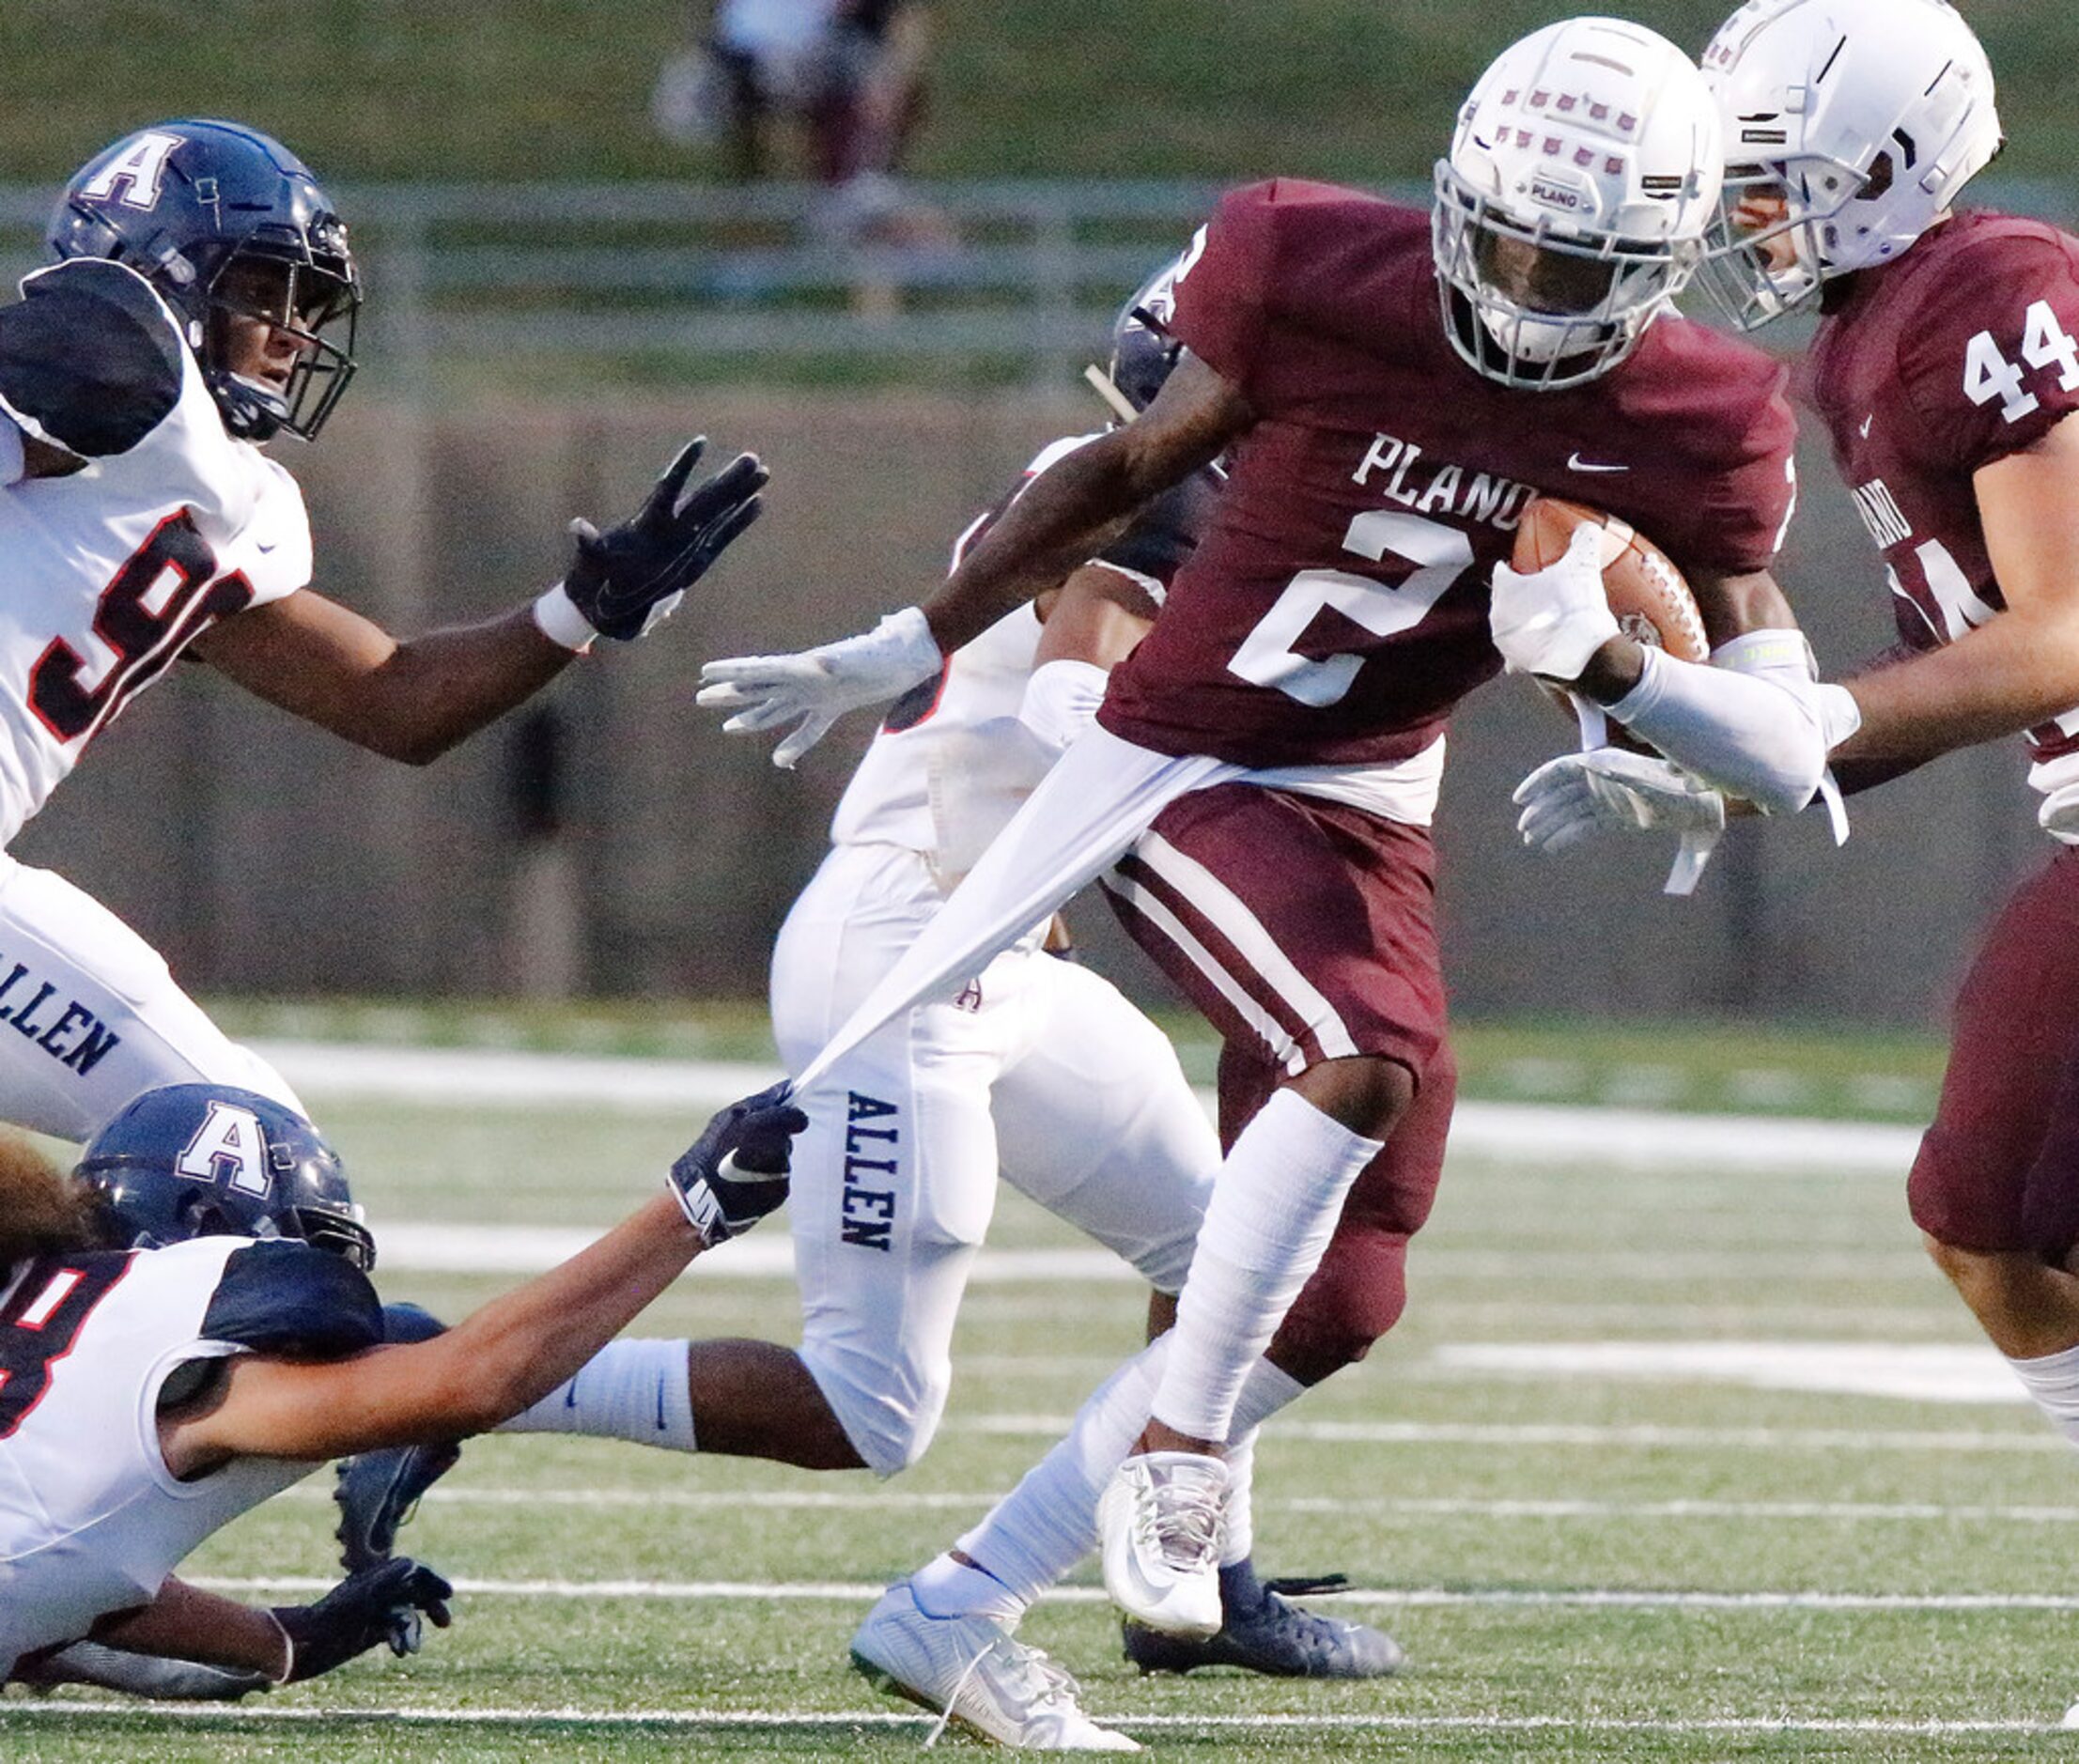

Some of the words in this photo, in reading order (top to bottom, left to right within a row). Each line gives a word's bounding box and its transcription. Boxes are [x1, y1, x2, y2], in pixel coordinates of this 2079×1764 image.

[78, 132, 188, 211] A
[1531, 184, 1577, 208] PLANO
[1963, 300, 2079, 424] 44
[1351, 431, 1541, 531] PLANO
[1226, 509, 1475, 707] 2
[0, 952, 120, 1076] LLEN
[953, 977, 983, 1014] A
[174, 1099, 272, 1200] A
[842, 1091, 898, 1252] ALLEN
